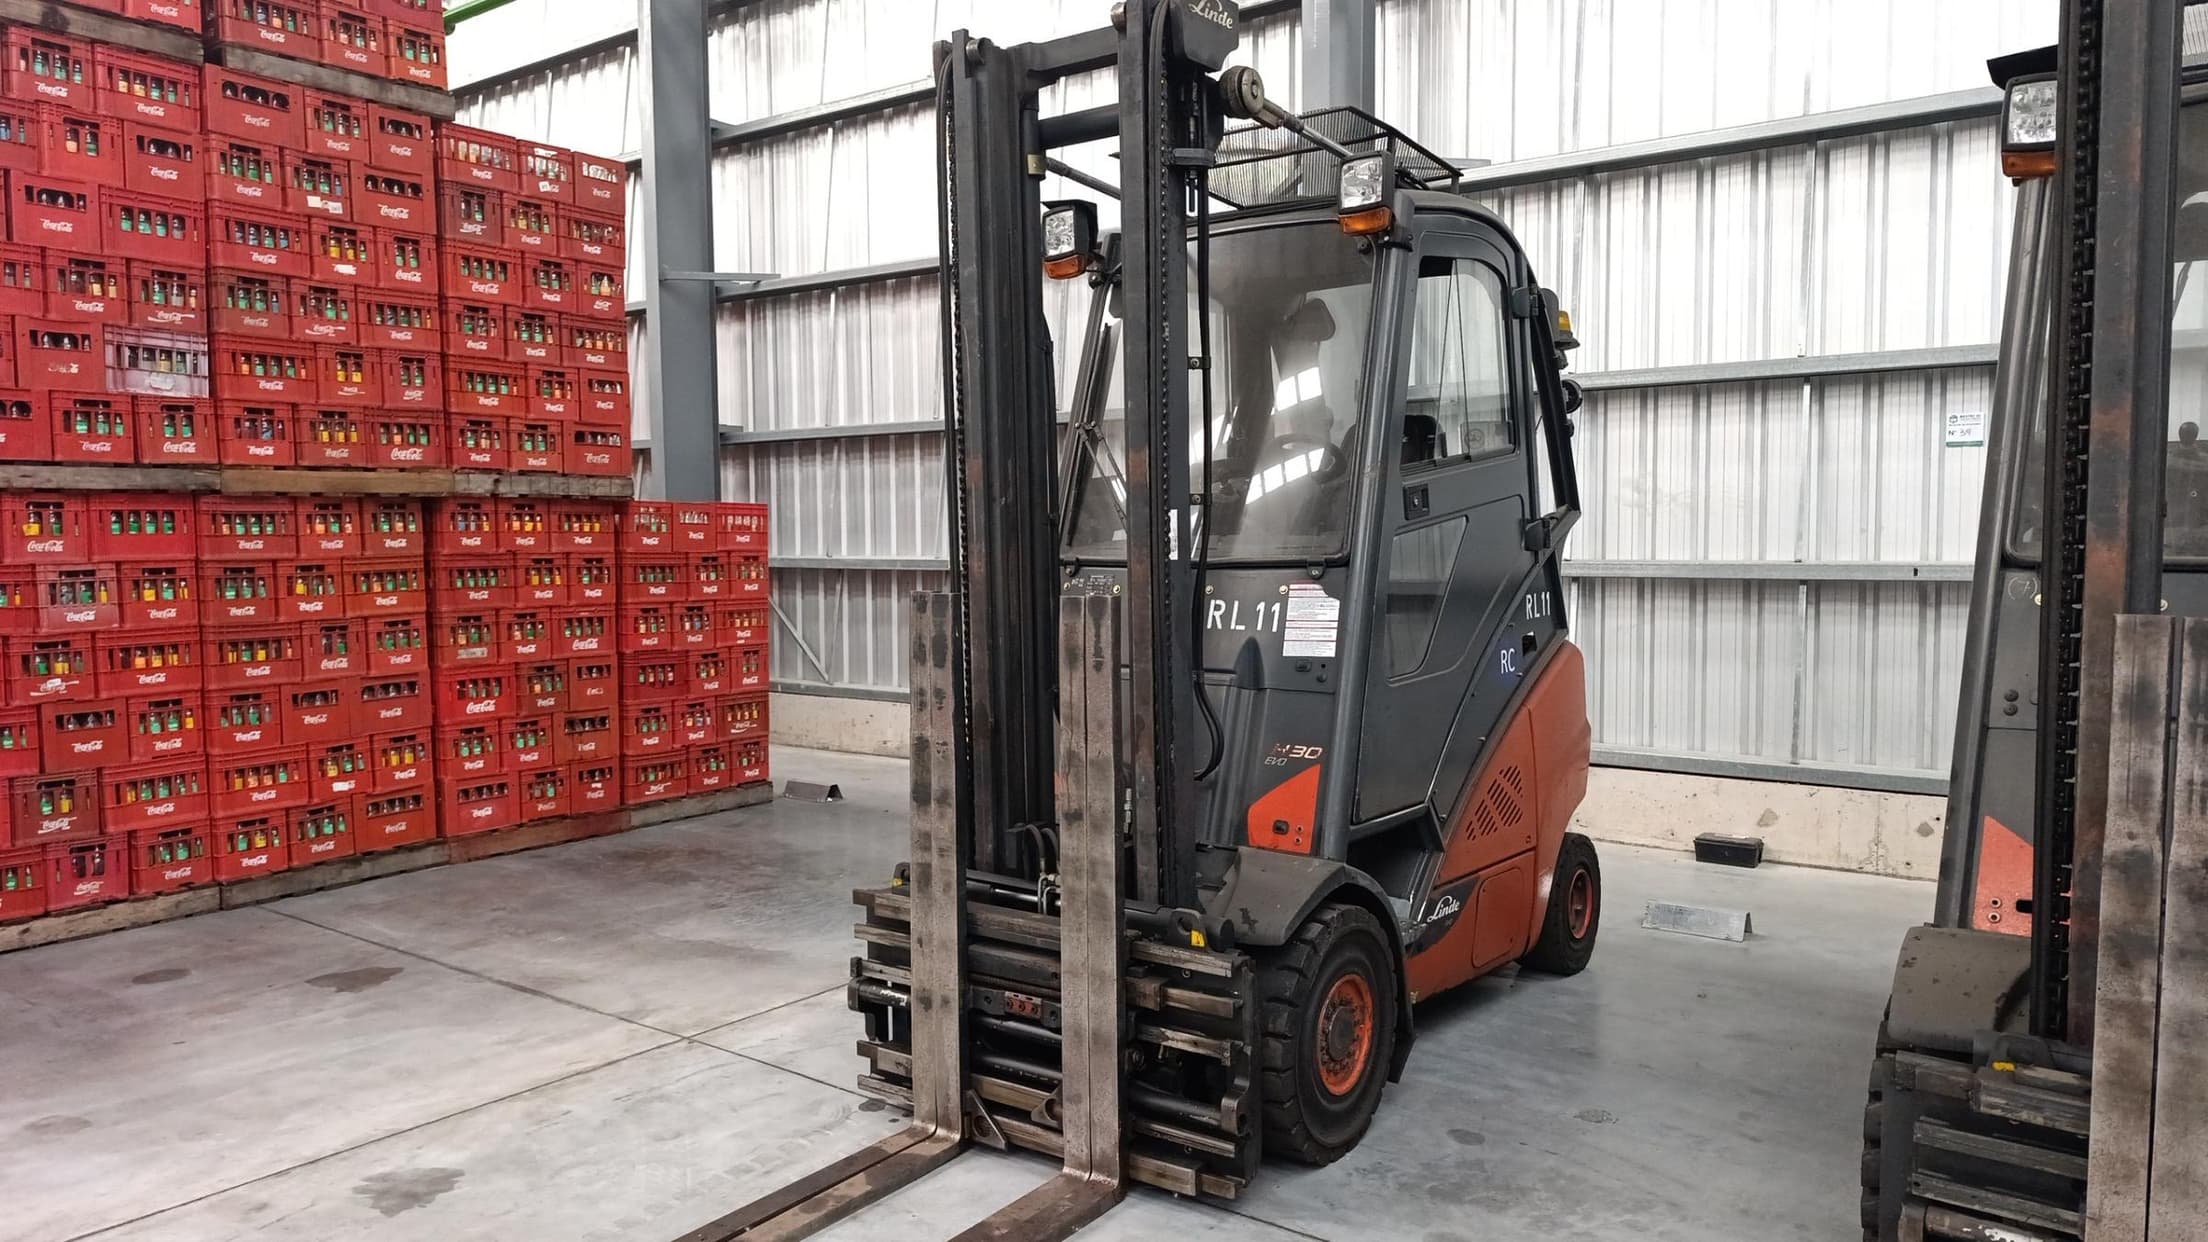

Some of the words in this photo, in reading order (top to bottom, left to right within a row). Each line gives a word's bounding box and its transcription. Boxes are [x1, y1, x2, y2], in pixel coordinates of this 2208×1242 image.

[1188, 0, 1233, 29] Linde
[1500, 648, 1516, 674] RC
[1264, 756, 1288, 766] EVO
[1427, 895, 1461, 923] Linde
